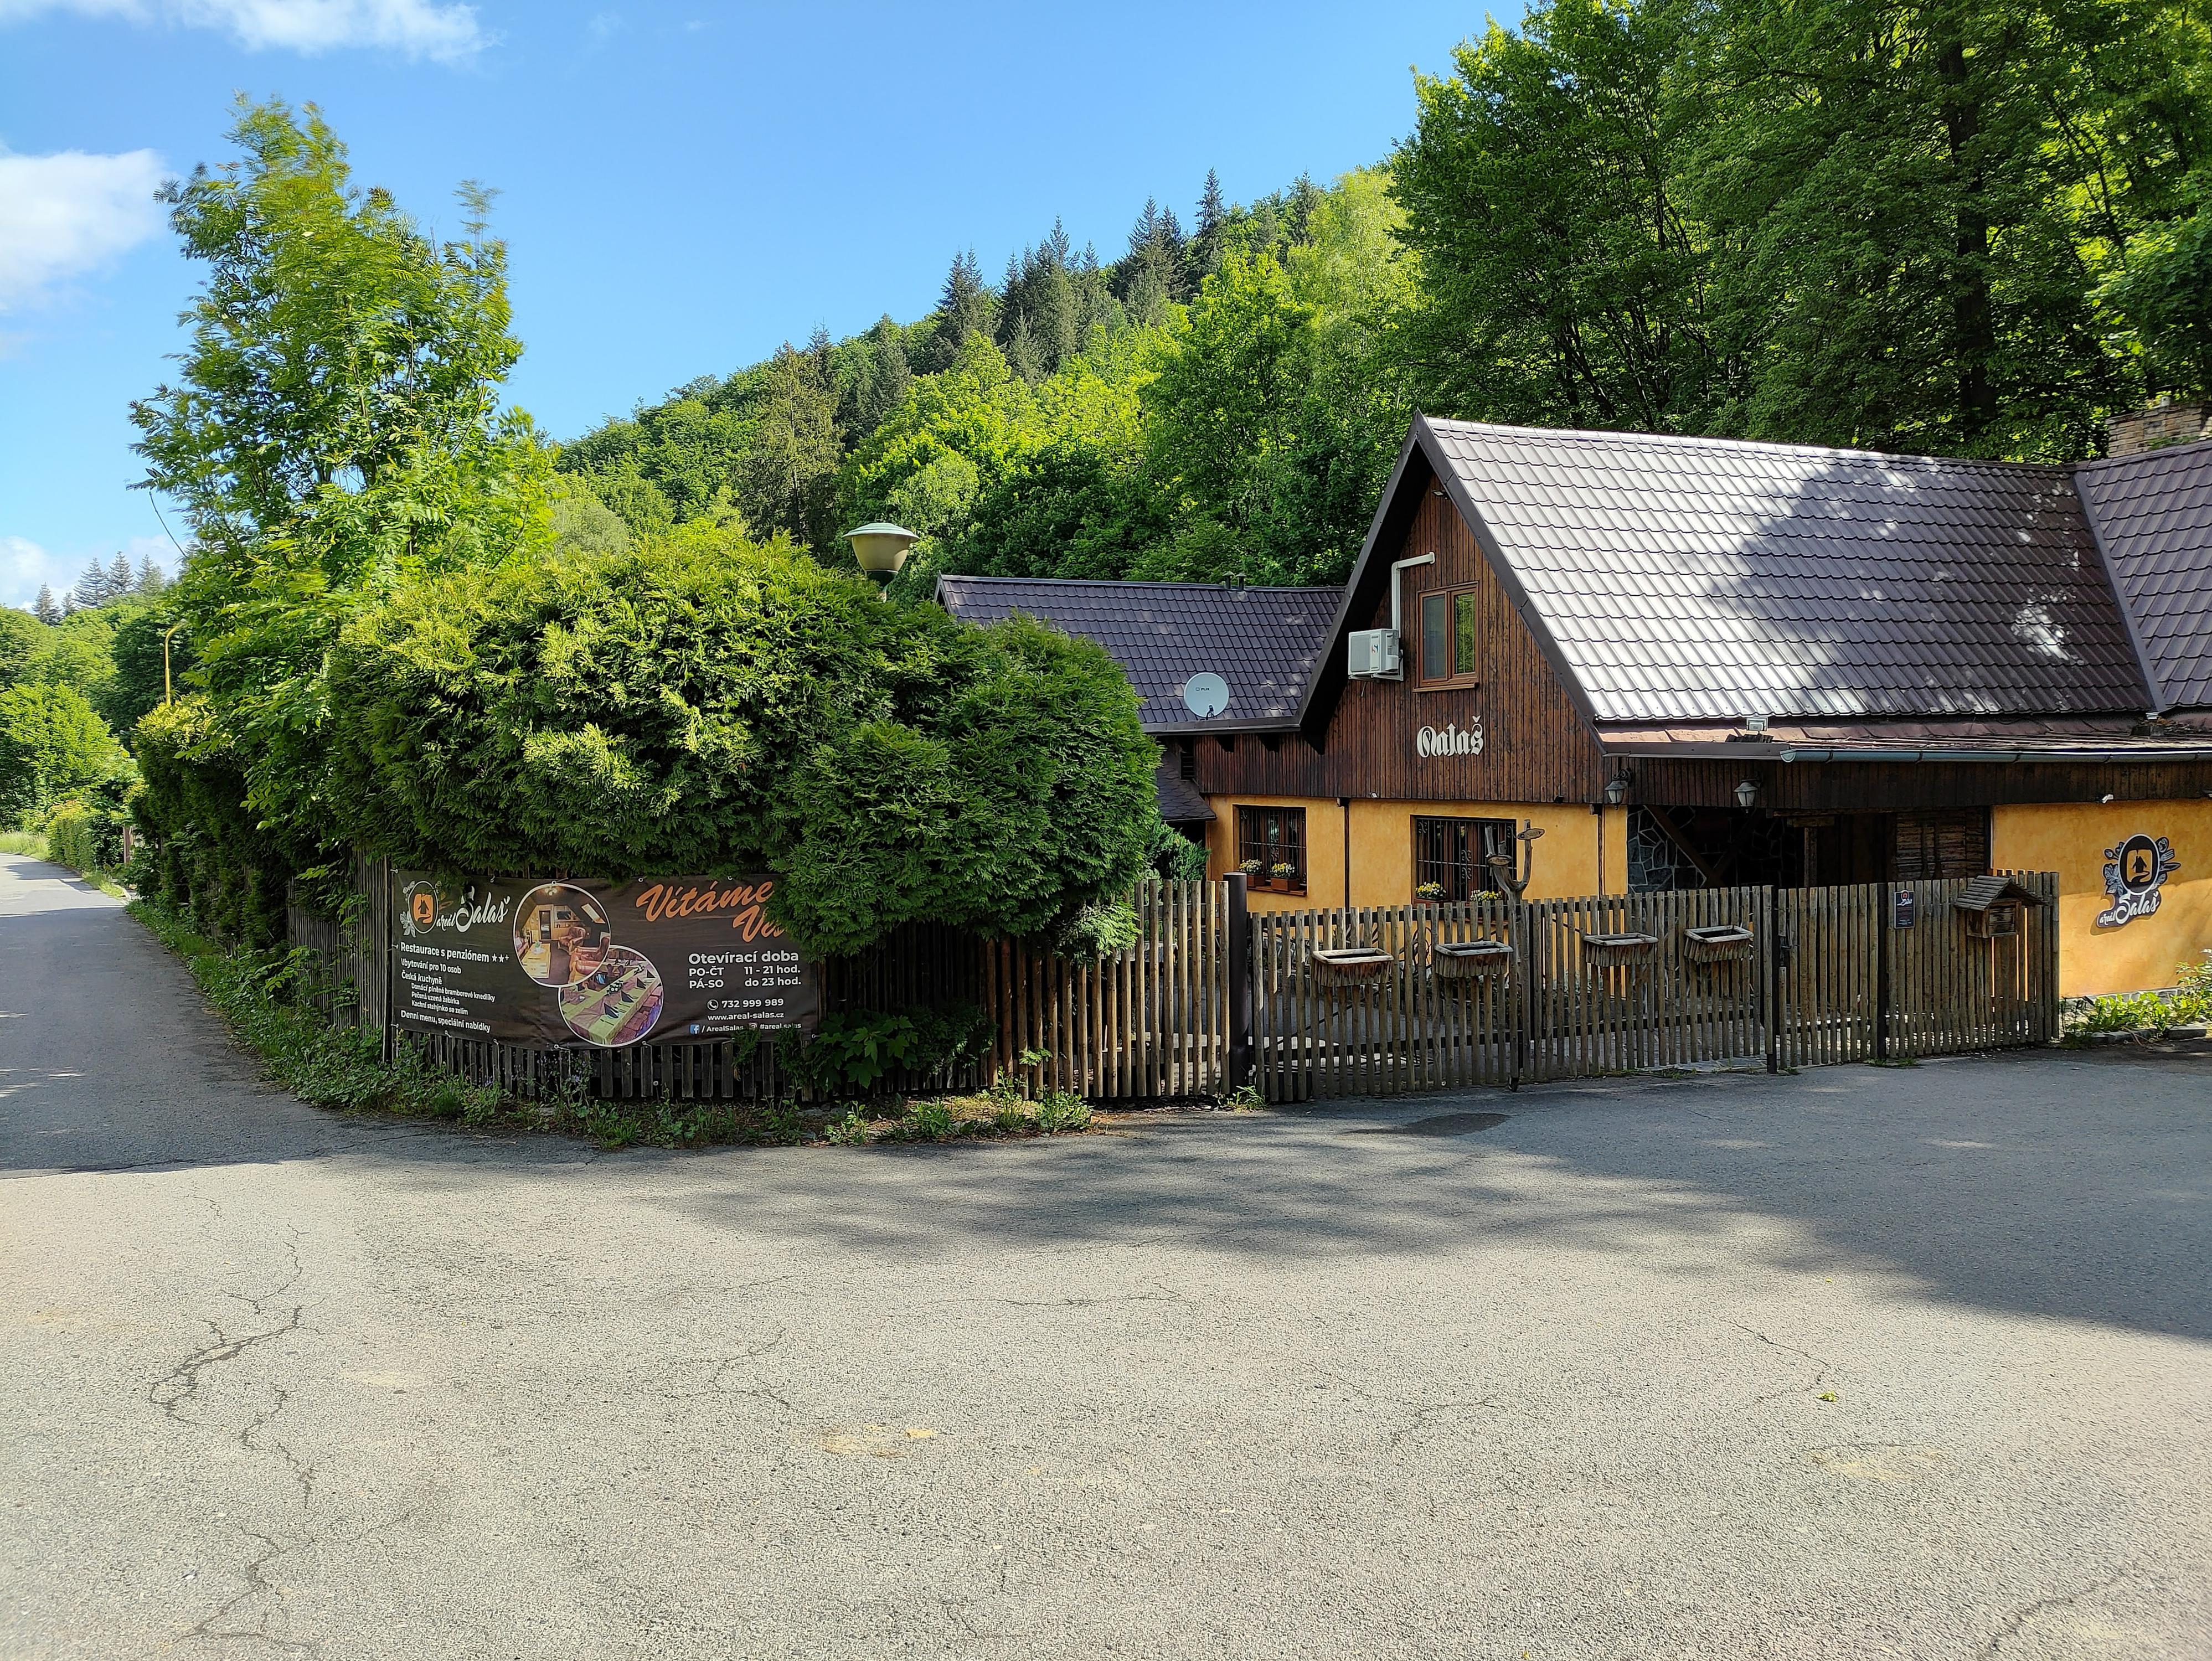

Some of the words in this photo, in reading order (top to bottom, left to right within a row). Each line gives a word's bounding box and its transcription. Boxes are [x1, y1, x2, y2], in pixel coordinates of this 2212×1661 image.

[636, 880, 775, 922] Vítáme
[2099, 910, 2116, 926] areál
[2115, 891, 2159, 925] Salaš
[436, 912, 456, 931] areál
[400, 941, 439, 956] Restaurace
[447, 949, 489, 963] penziónem
[688, 951, 759, 964] Otevírací
[761, 950, 799, 963] doba
[400, 958, 428, 971] Ubytování
[429, 963, 439, 972] pro
[440, 964, 446, 972] 10
[447, 965, 462, 974] osob
[689, 966, 724, 977] PO-ČT
[744, 966, 753, 975] 11
[762, 966, 773, 974] 21
[776, 964, 801, 974] hod.
[401, 969, 417, 981] Česká
[417, 973, 442, 986] kuchyně
[689, 978, 724, 989] PÁ-SO
[744, 978, 759, 987] do
[761, 977, 775, 986] 23
[777, 977, 801, 986] hod.
[411, 983, 428, 991] Domácí
[445, 988, 473, 998] bramborové
[473, 992, 496, 1003] knedlíky
[411, 992, 427, 1000] Pečená
[442, 997, 460, 1005] žebírka
[411, 999, 427, 1008] Kachní
[455, 1007, 468, 1015] zelím
[721, 1000, 740, 1008] 732
[743, 999, 762, 1008] 999
[765, 998, 784, 1007] 989
[401, 1010, 419, 1020] Denní
[419, 1013, 437, 1024] menu,
[438, 1017, 465, 1028] speciální
[465, 1022, 491, 1033] nabídky
[707, 1011, 784, 1020] www.areal-salas.cz
